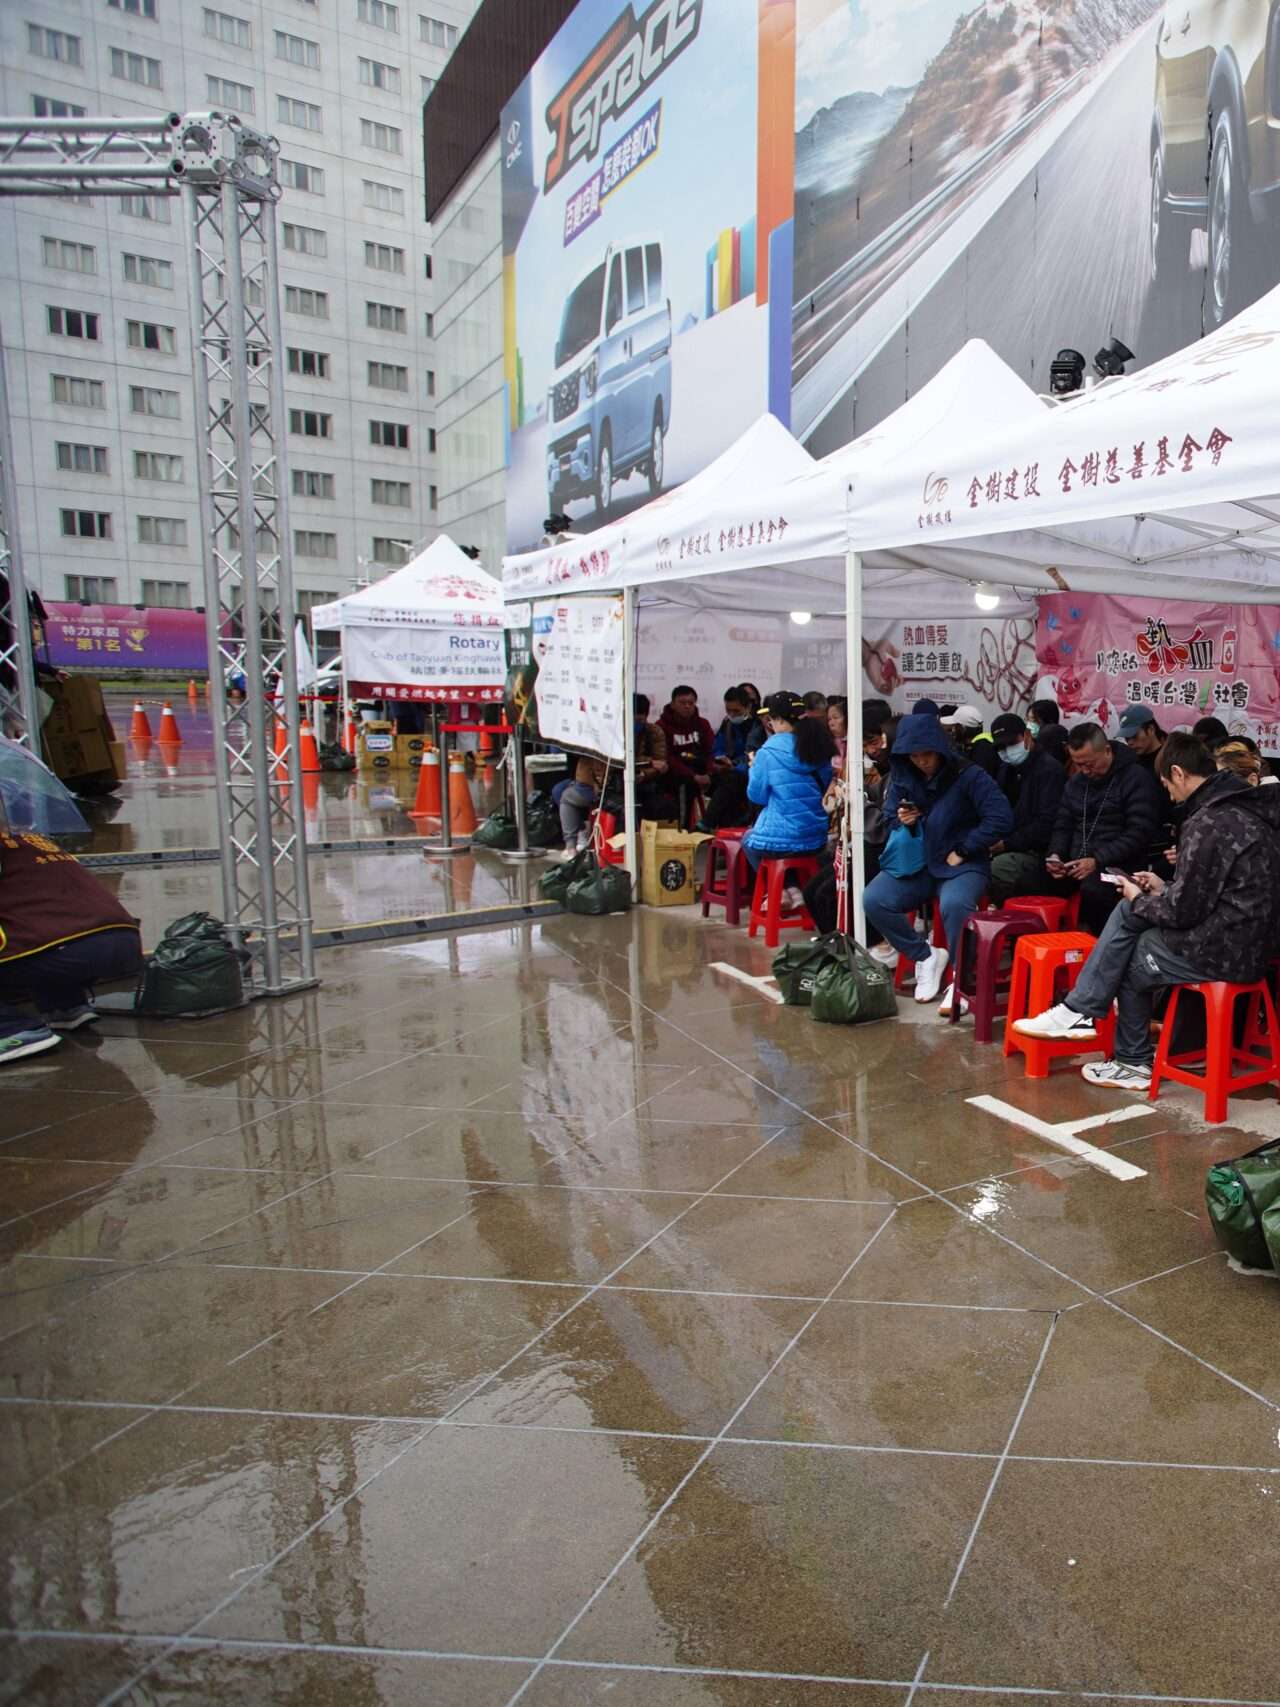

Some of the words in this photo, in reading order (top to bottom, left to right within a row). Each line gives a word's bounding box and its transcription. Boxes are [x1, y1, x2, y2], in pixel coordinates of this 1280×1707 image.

[966, 463, 1041, 508] 金樹建設
[1058, 427, 1232, 493] 金樹慈善基金會
[76, 638, 121, 652] 第1名
[449, 635, 500, 651] Rotary
